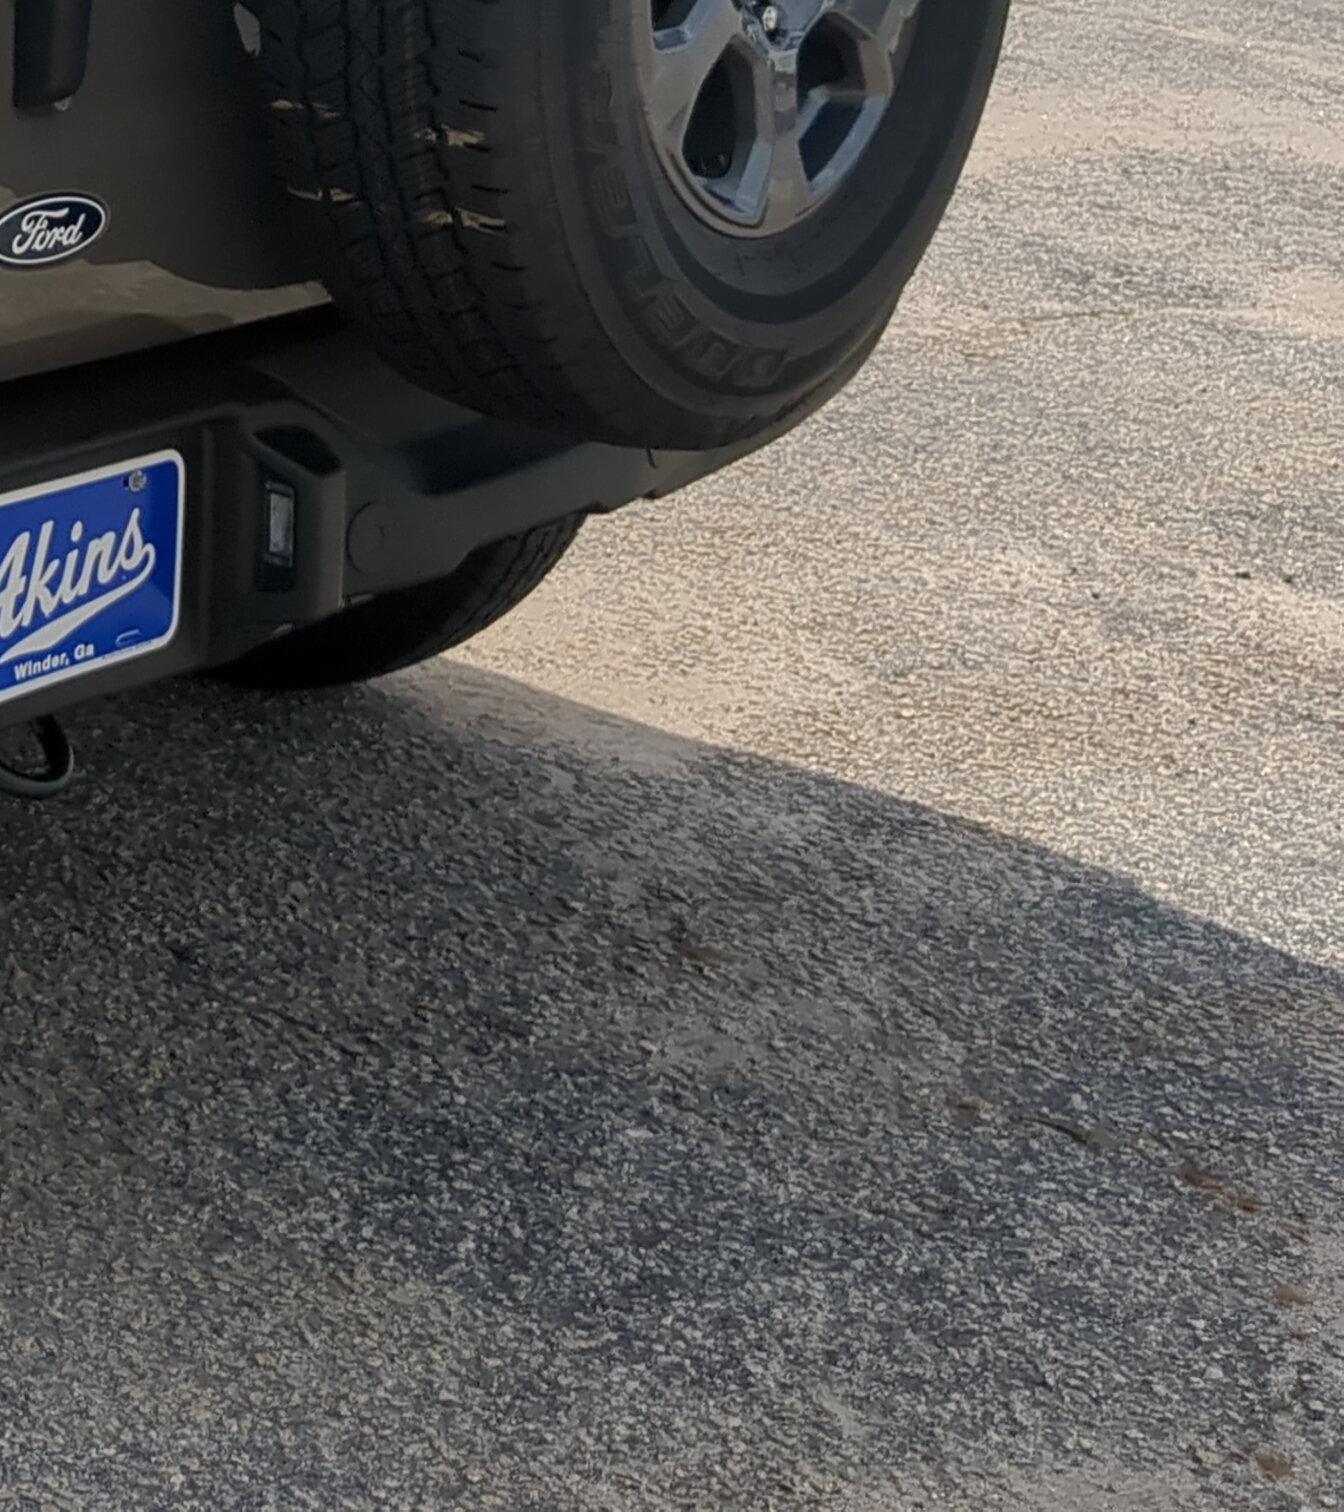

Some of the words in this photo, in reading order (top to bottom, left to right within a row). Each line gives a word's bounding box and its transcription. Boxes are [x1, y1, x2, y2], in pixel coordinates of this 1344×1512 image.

[12, 206, 86, 255] Ford
[13, 652, 70, 681] Winder,
[73, 643, 95, 661] Ga
